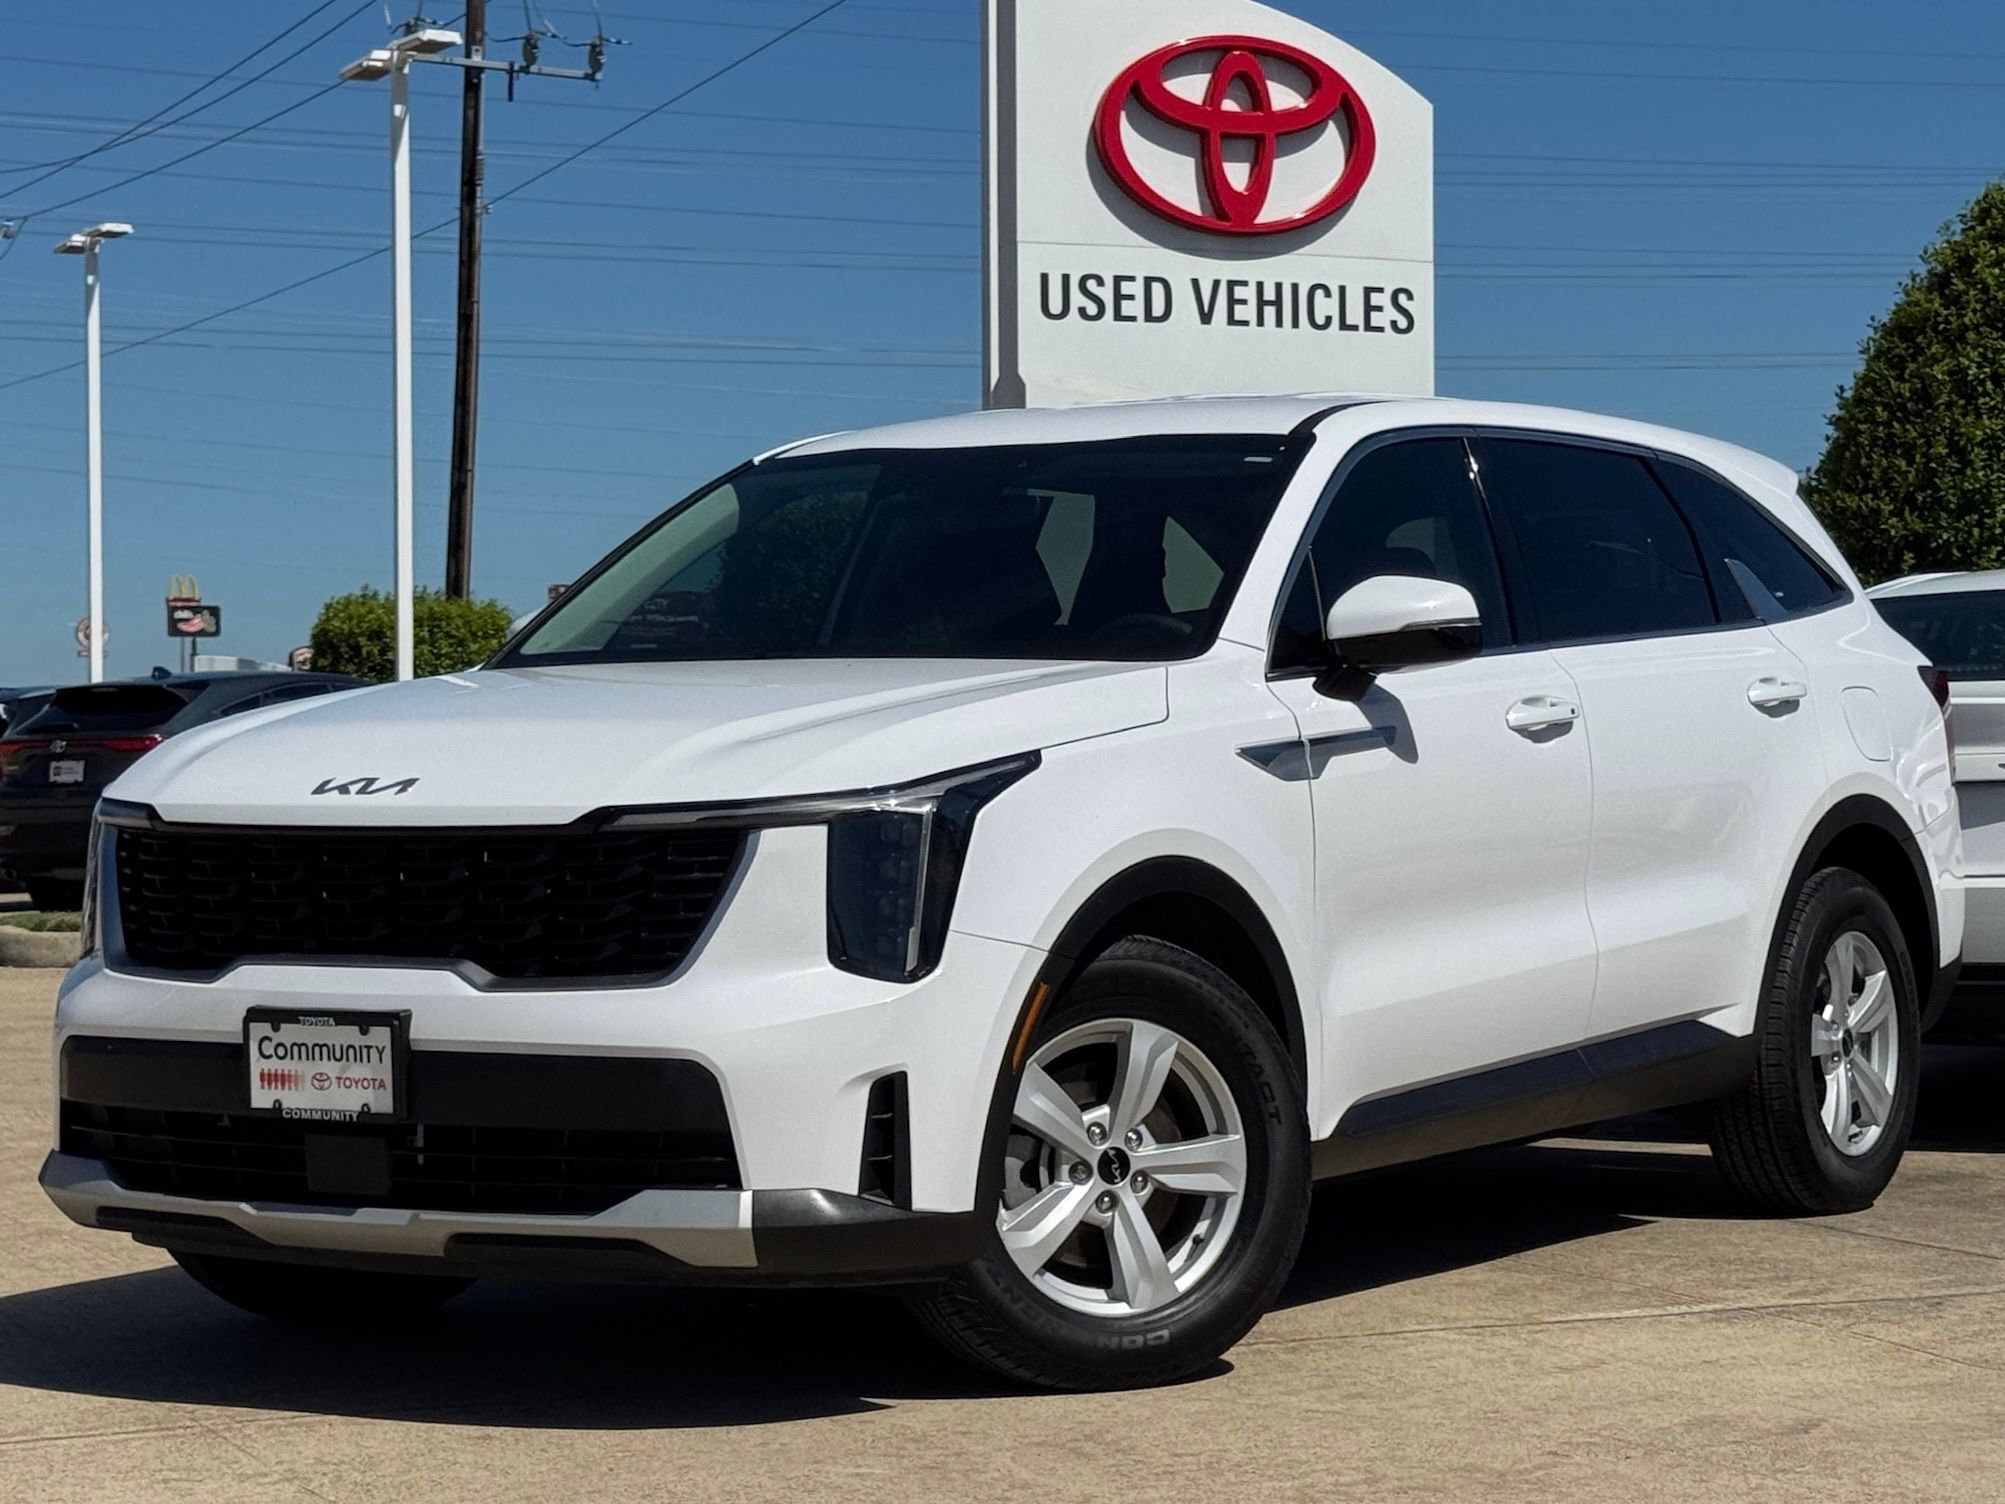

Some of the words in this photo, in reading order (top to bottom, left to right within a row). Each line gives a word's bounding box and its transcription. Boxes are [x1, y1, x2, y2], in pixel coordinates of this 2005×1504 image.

[1040, 272, 1173, 324] USED
[1190, 278, 1416, 335] VEHICLES
[310, 777, 420, 795] KIA
[299, 1016, 336, 1027] TOYOTA
[335, 1076, 387, 1091] TOYOTA
[282, 1108, 359, 1122] COMMUNITY
